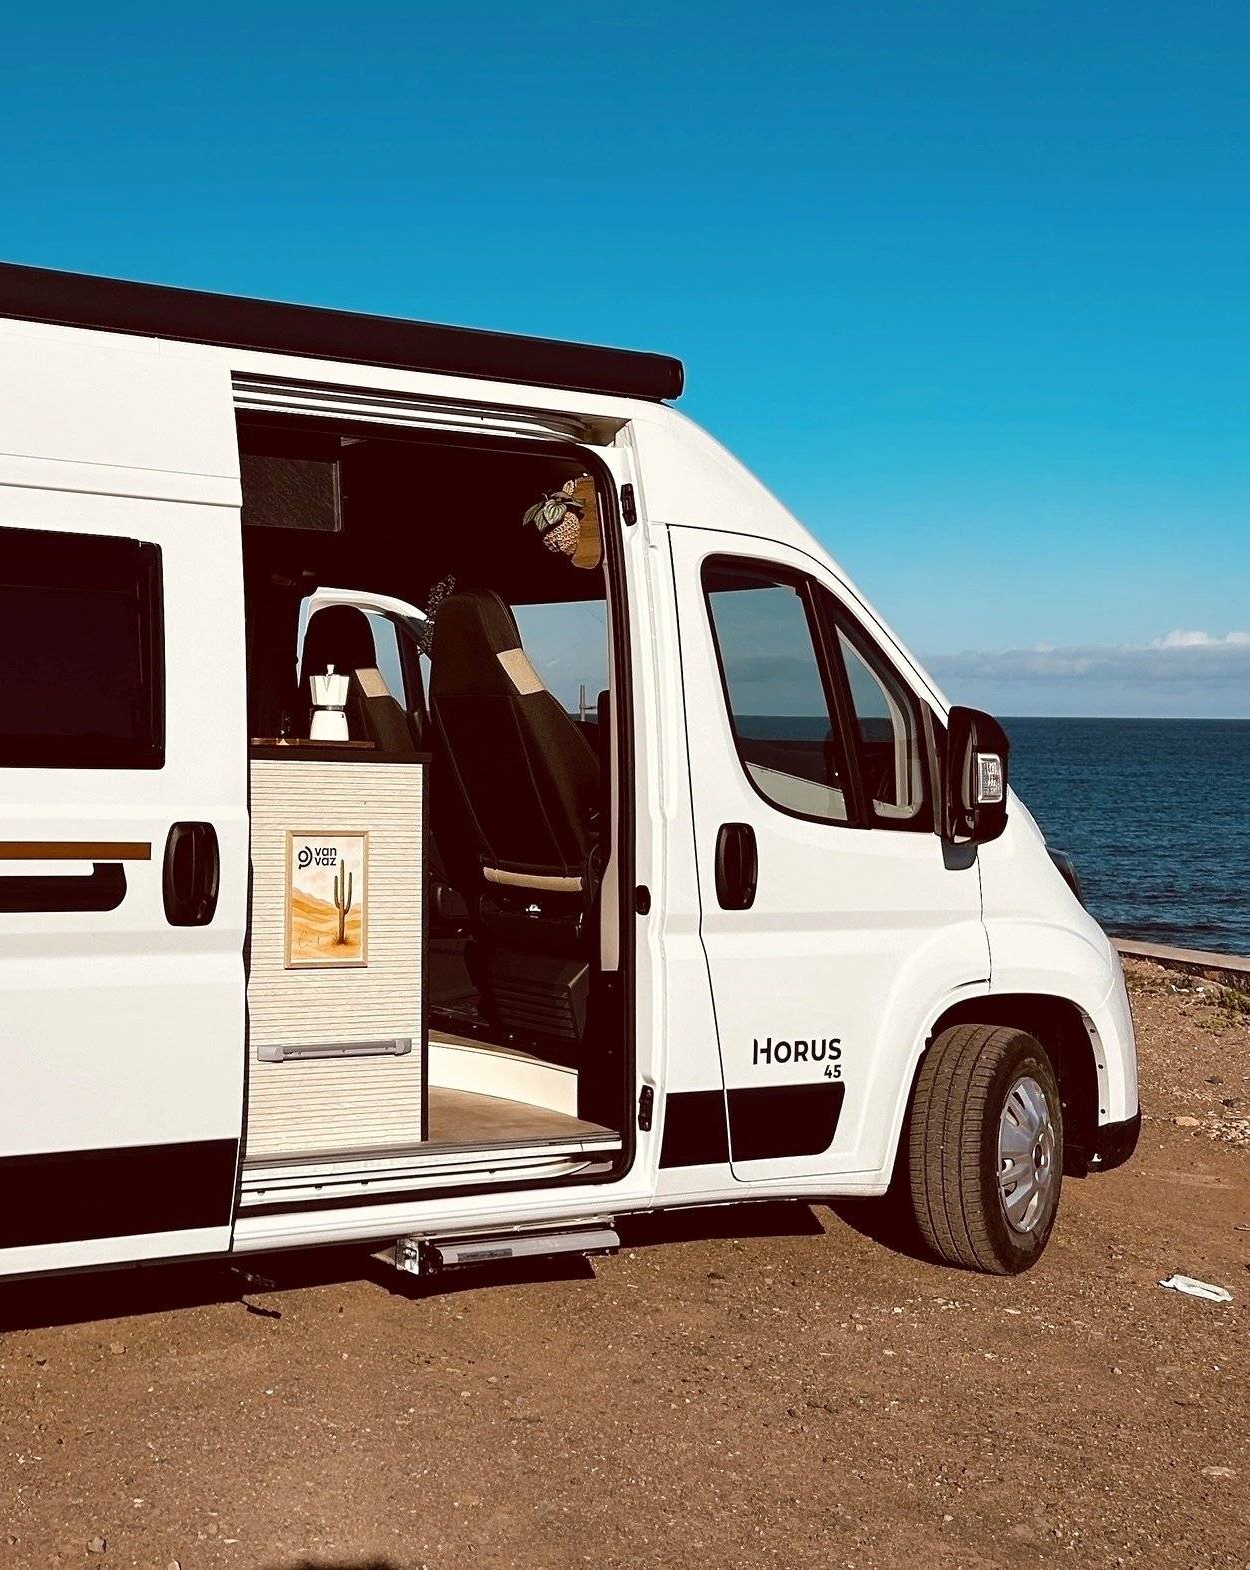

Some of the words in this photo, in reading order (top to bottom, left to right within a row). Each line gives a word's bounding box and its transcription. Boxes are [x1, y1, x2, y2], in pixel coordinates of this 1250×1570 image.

[314, 847, 337, 857] van
[314, 857, 337, 866] vaz
[824, 1064, 841, 1078] 45
